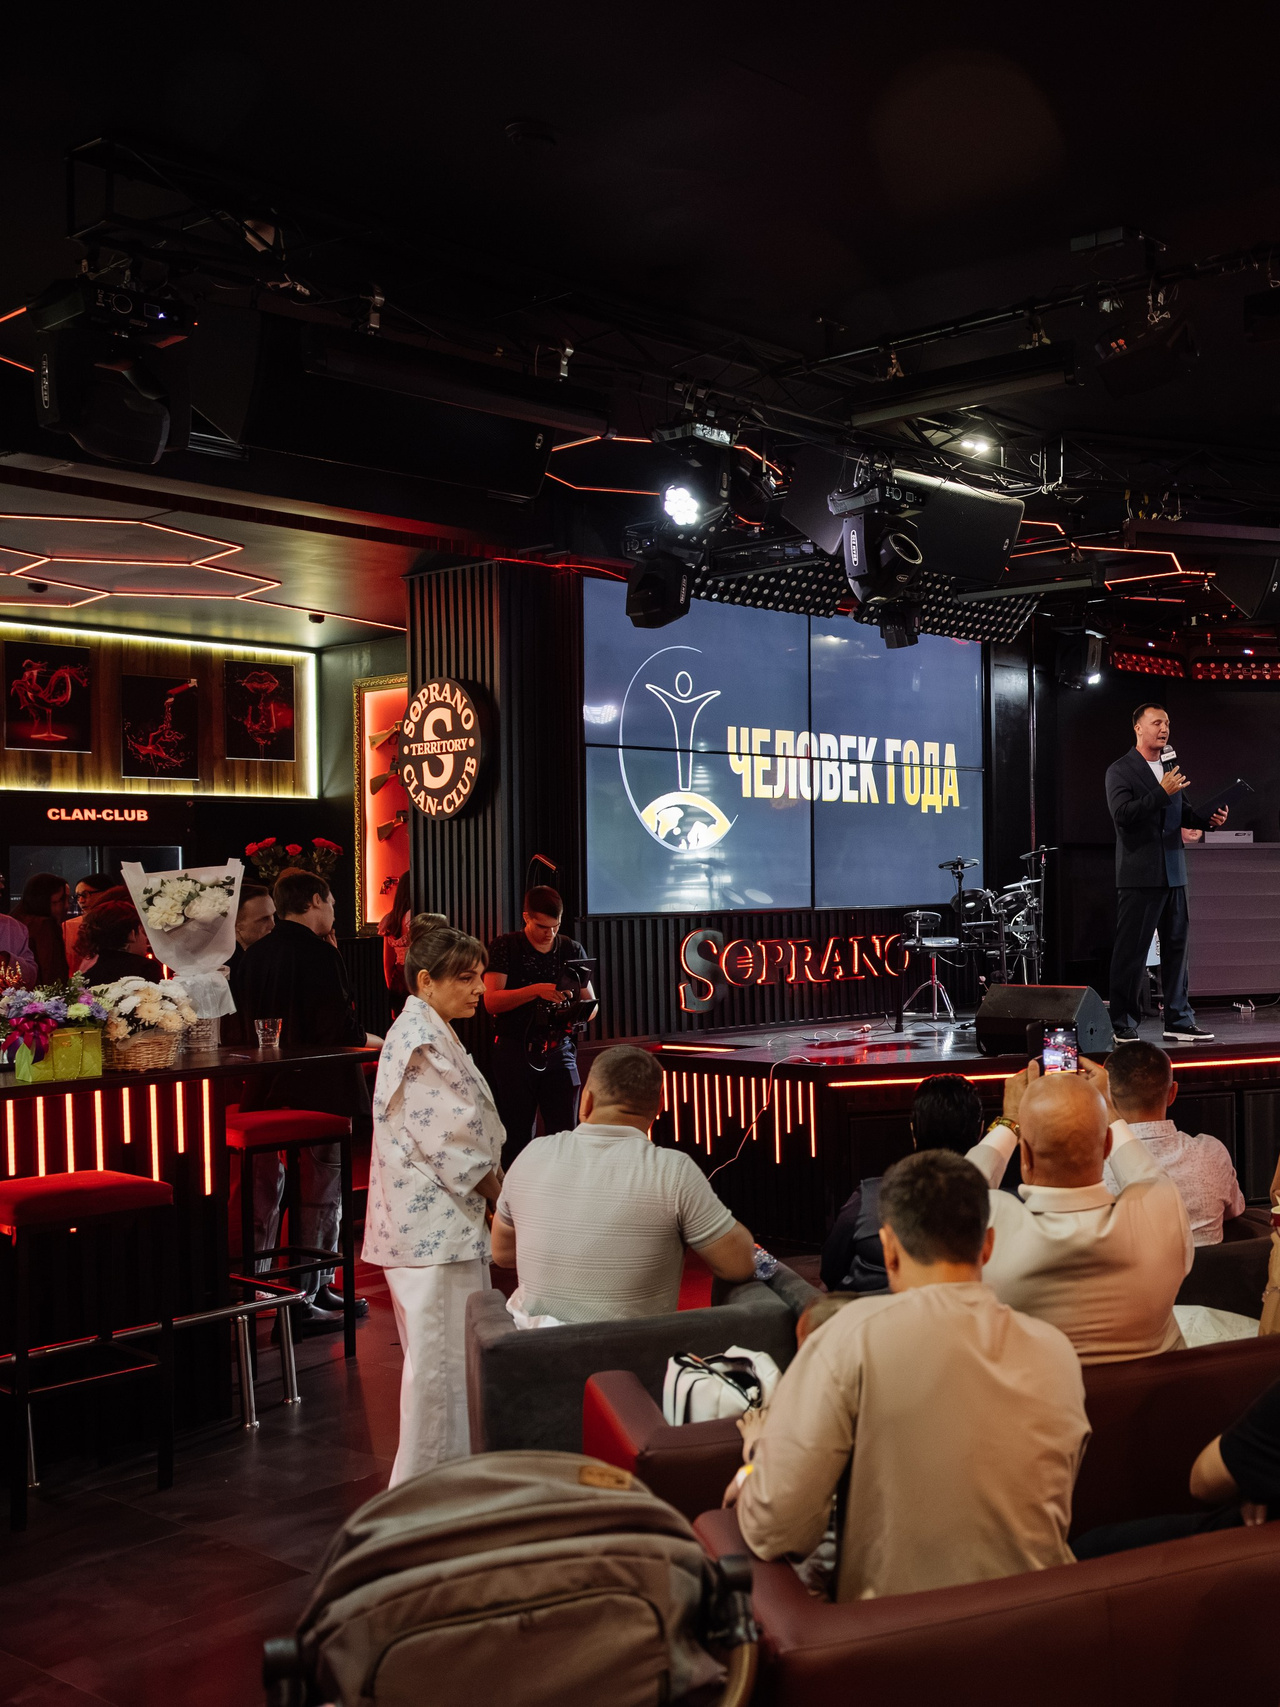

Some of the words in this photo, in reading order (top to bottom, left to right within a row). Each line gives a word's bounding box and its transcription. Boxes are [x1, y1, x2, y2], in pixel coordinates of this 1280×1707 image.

[403, 682, 475, 738] SOPRANO
[410, 737, 469, 756] TERRITORY
[422, 707, 454, 789] S
[727, 725, 880, 804] ЧЕЛОВЕК
[885, 738, 960, 814] ГОДА
[46, 807, 149, 822] CLAN-CLUB
[403, 756, 477, 816] CLAN-CLUB
